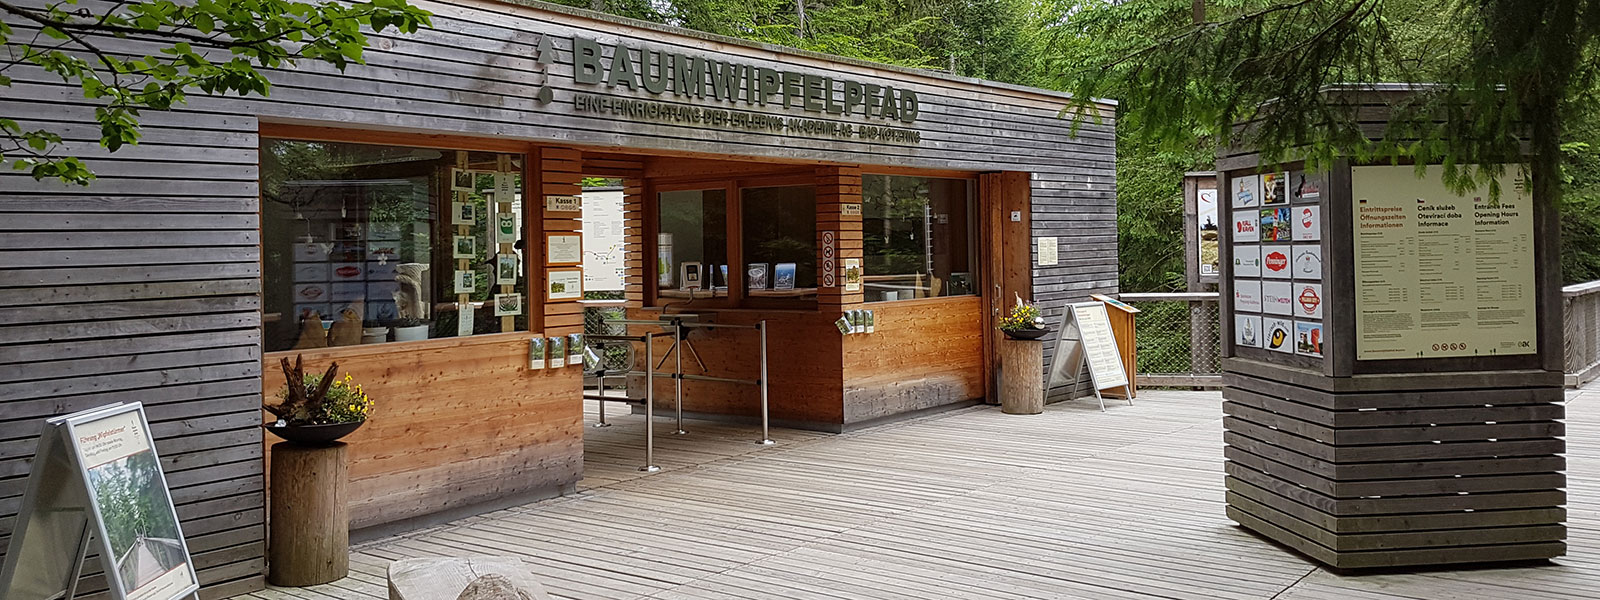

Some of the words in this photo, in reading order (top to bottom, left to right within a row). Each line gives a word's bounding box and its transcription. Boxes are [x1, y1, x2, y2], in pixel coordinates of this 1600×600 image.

[573, 35, 919, 123] BAUMWIPFELPFAD
[574, 93, 609, 115] EINE
[611, 97, 701, 122] EINRICHTUNG
[703, 108, 730, 127] DER
[731, 111, 784, 131] ERLEBNIS
[787, 117, 837, 137] AKADEMIE
[838, 122, 853, 138] AG
[859, 125, 878, 140] BAD
[1360, 205, 1403, 213] Eintrittspreise
[1360, 213, 1407, 221] Öffnungszeiten
[1360, 221, 1404, 229] Informationen
